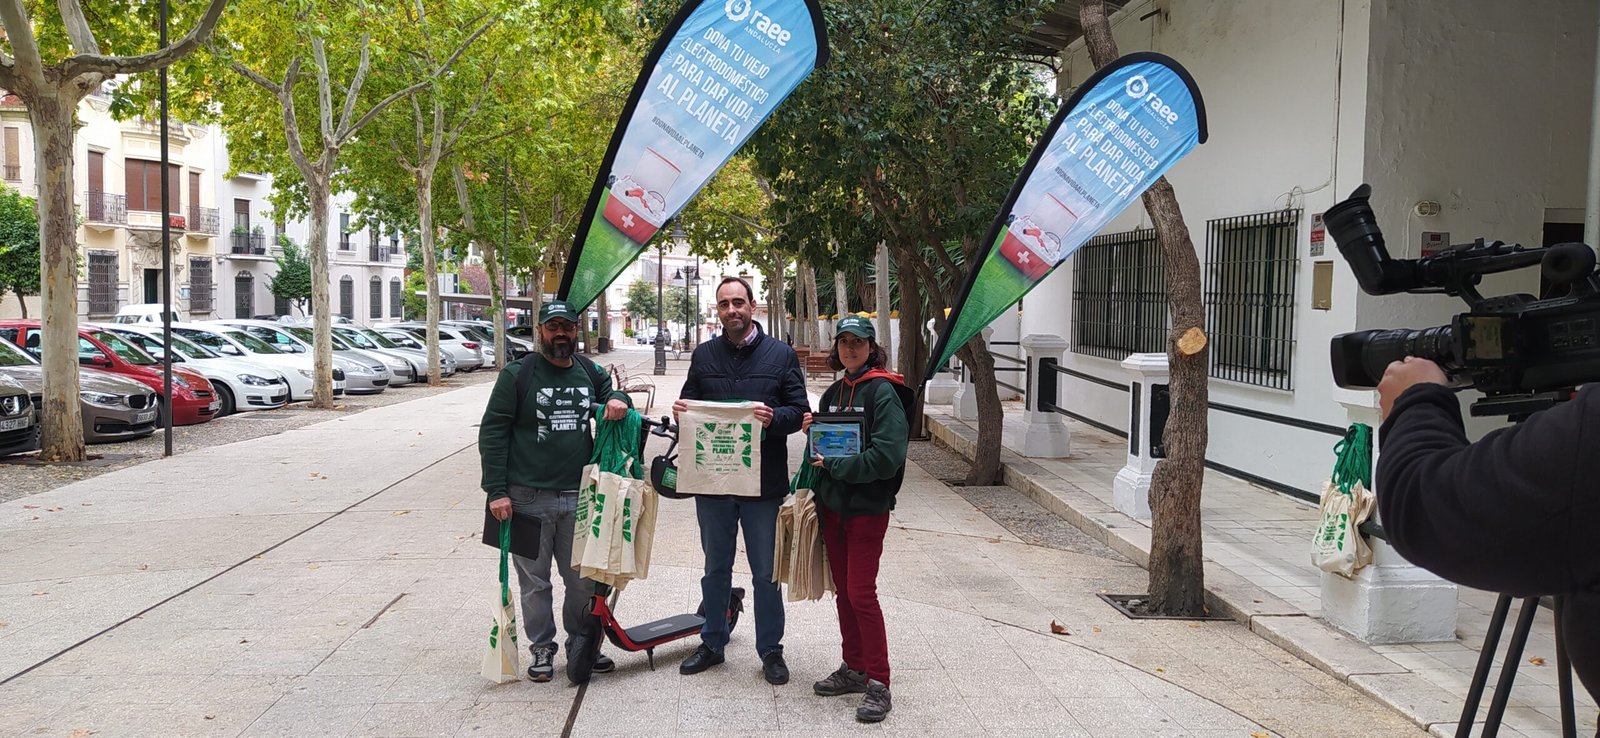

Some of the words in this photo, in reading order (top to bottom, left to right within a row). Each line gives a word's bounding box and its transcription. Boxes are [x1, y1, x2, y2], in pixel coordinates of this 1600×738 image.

[703, 28, 729, 53] DONA
[729, 44, 744, 62] TU
[744, 53, 770, 80] VIEJO
[744, 26, 781, 54] ANDALUCÍA
[750, 10, 791, 47] raee
[672, 54, 701, 86] PARA
[701, 74, 729, 103] DAR
[725, 93, 754, 122] VIDA
[681, 37, 769, 105] ELECTRODOMÉSTICO
[657, 73, 679, 100] AL
[679, 87, 741, 145] PLANETA
[1106, 99, 1129, 122] DONA
[1126, 116, 1139, 131] TU
[1136, 124, 1159, 149] VIEJO
[1146, 92, 1178, 125] raee
[652, 116, 705, 159] #DONAVIDAALPLANETA
[1076, 117, 1105, 146] PARA
[1100, 138, 1124, 163] DAR
[1119, 156, 1145, 184] VIDA
[1086, 103, 1159, 170] ELECTRODOMÉSTICO
[1061, 132, 1081, 155] AL
[1079, 150, 1136, 200] PLANETA
[551, 423, 577, 431] PLANETA
